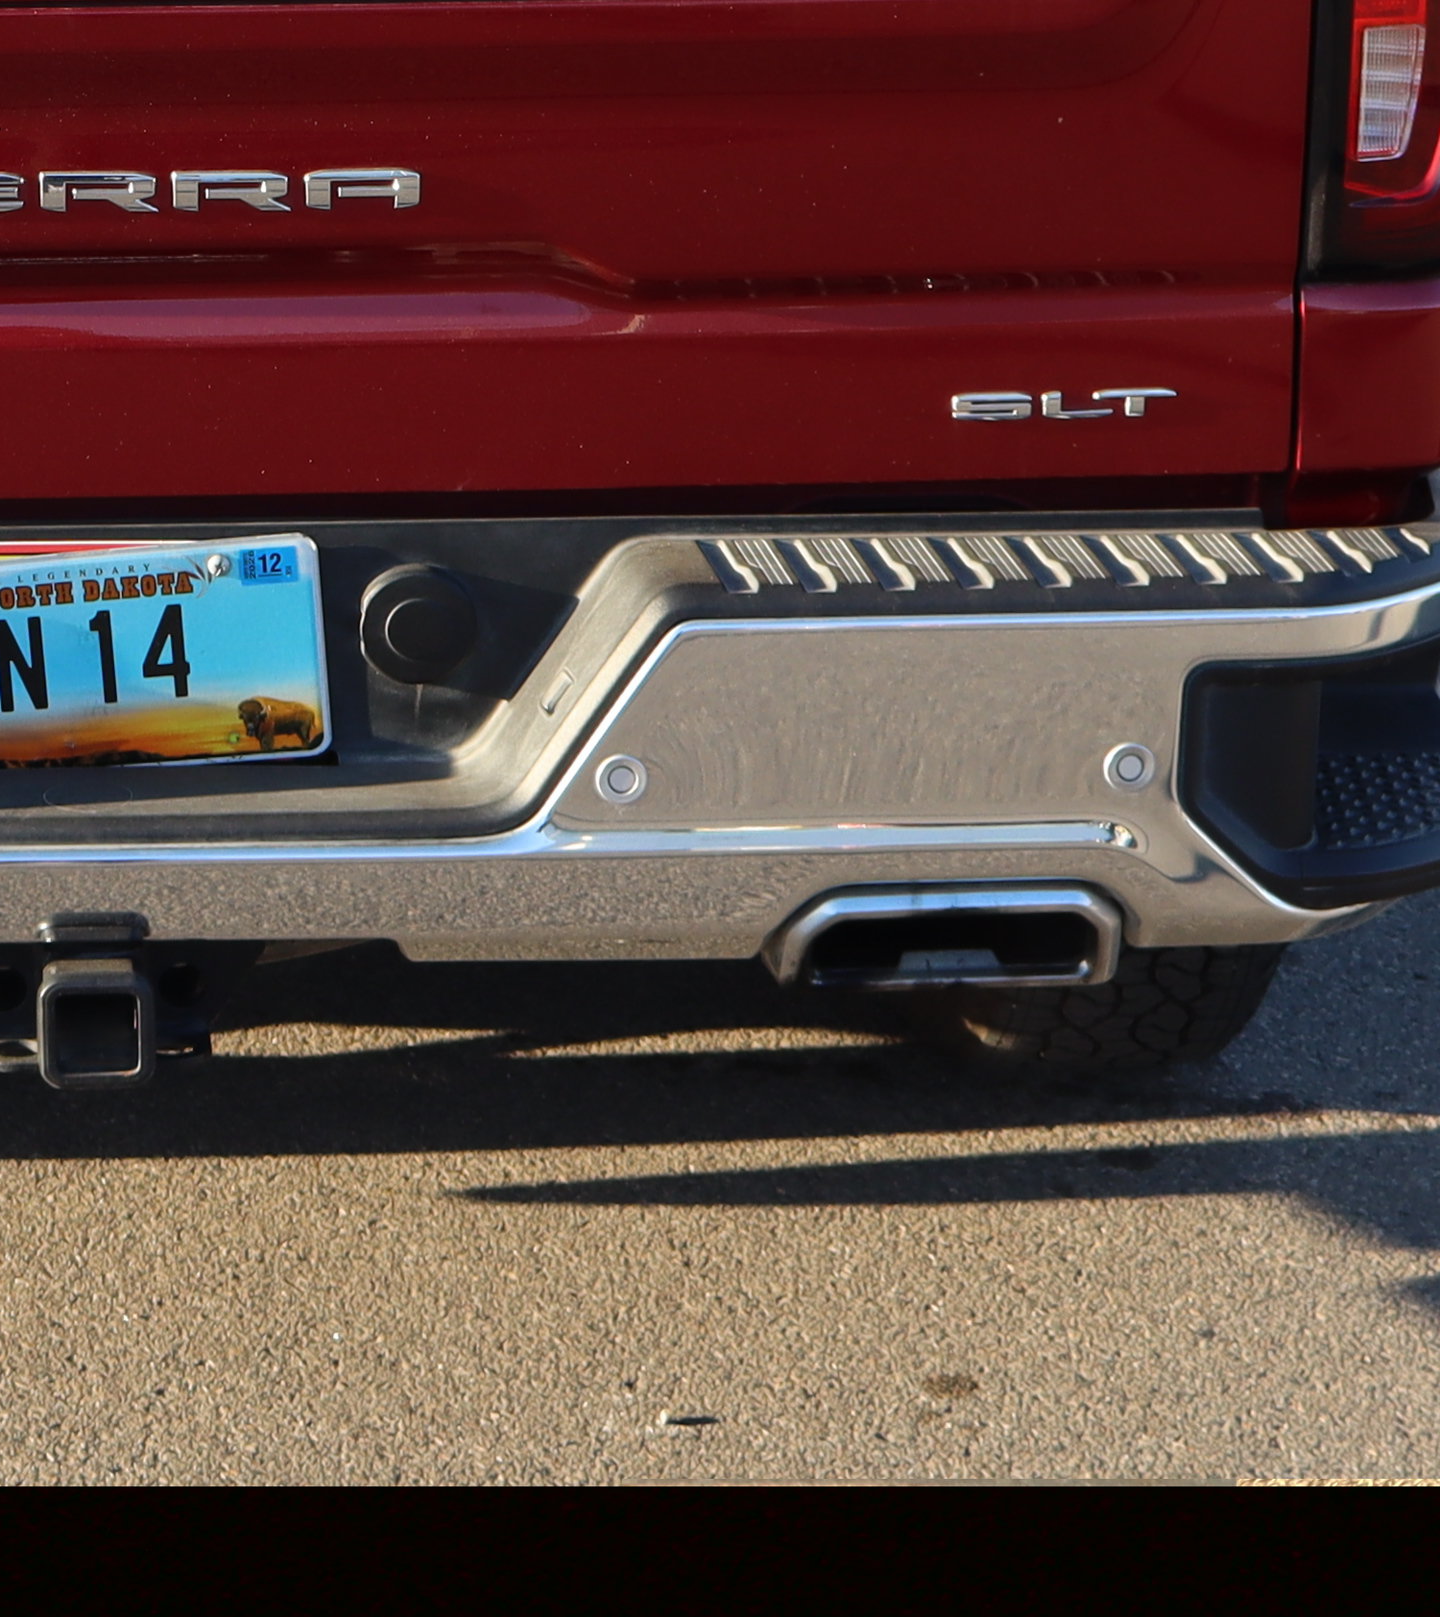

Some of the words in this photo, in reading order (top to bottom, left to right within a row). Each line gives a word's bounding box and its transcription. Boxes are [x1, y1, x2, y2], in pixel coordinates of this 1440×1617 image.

[951, 388, 1177, 421] SLT
[17, 563, 151, 583] LEGENDARY
[258, 552, 282, 573] 12
[82, 571, 194, 603] DAKOTA
[89, 604, 190, 704] 14
